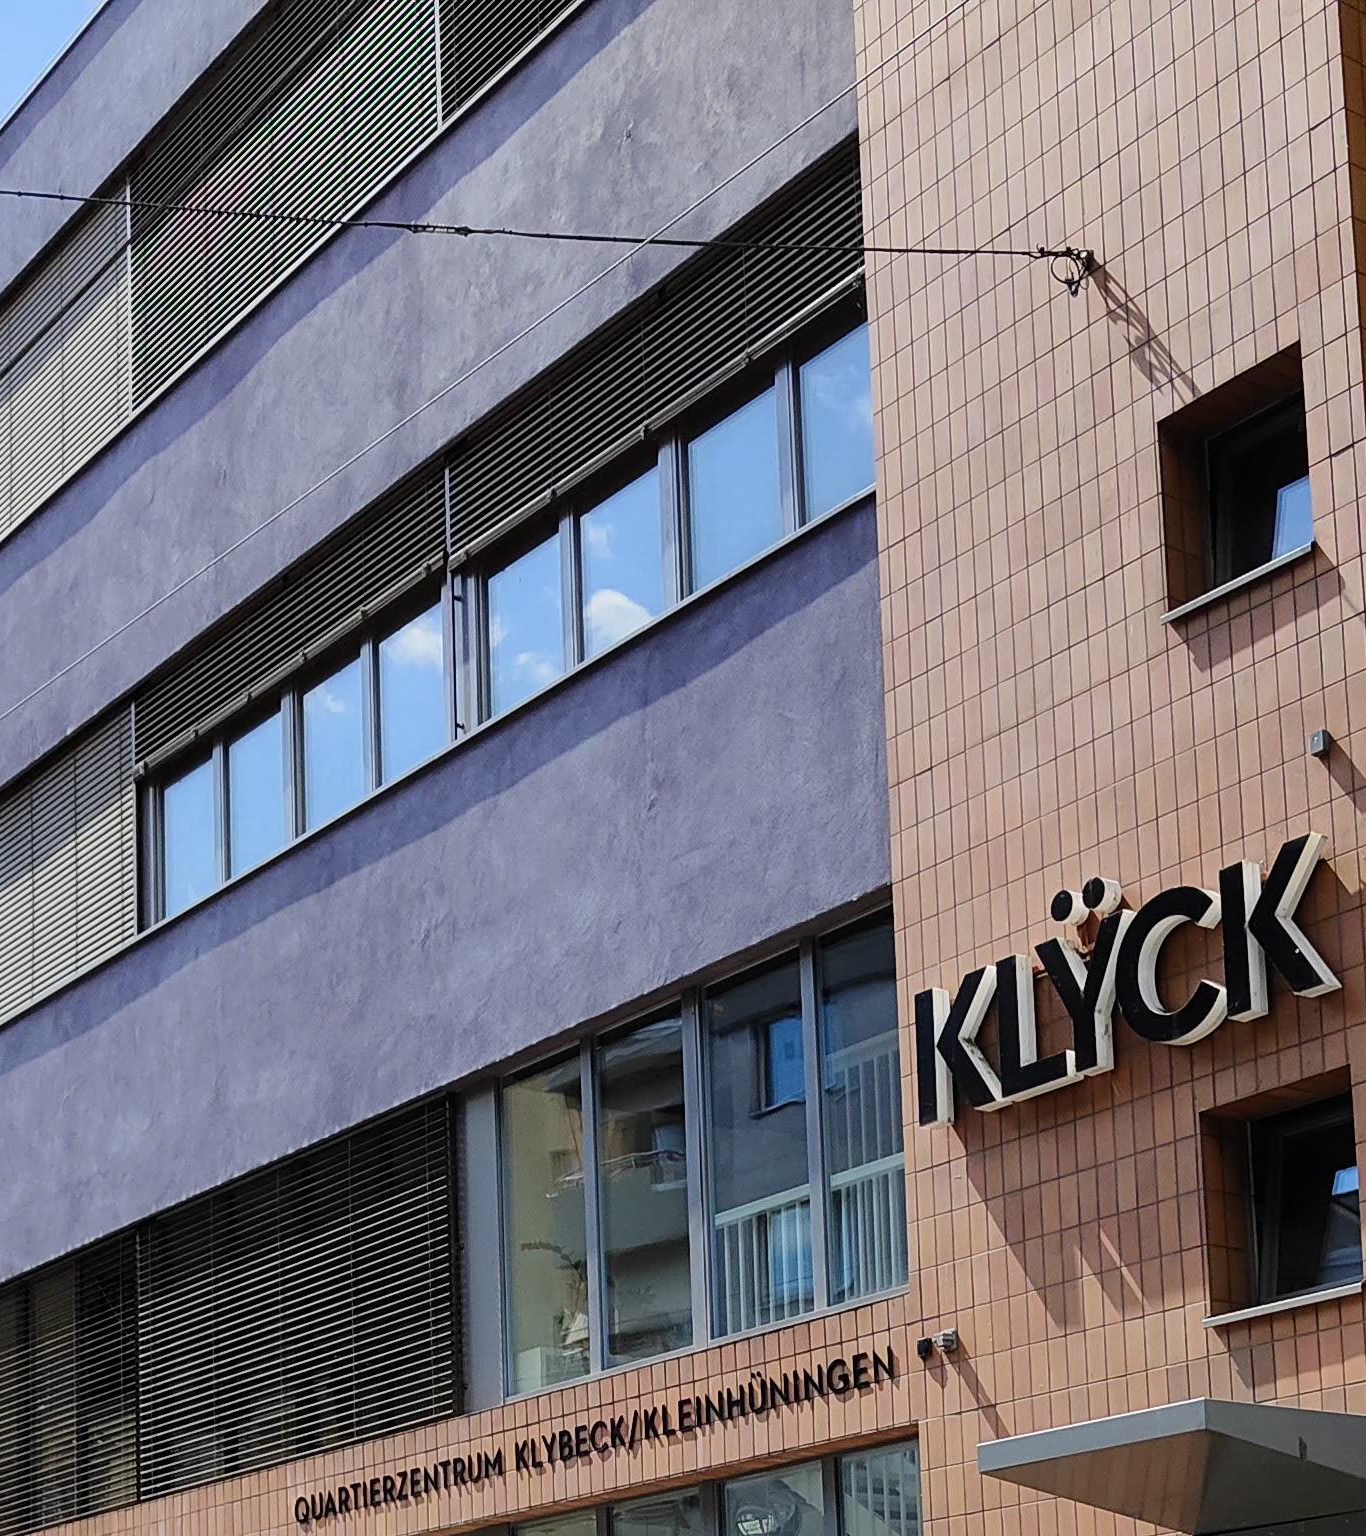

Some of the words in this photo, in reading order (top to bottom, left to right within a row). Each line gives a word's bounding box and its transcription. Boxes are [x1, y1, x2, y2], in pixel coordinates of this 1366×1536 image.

[915, 832, 1341, 1128] KLŸCK
[293, 1446, 504, 1526] QUARTIERZENTRUM
[514, 1346, 895, 1473] KLYBECK/KLEINHÜNINGEN
